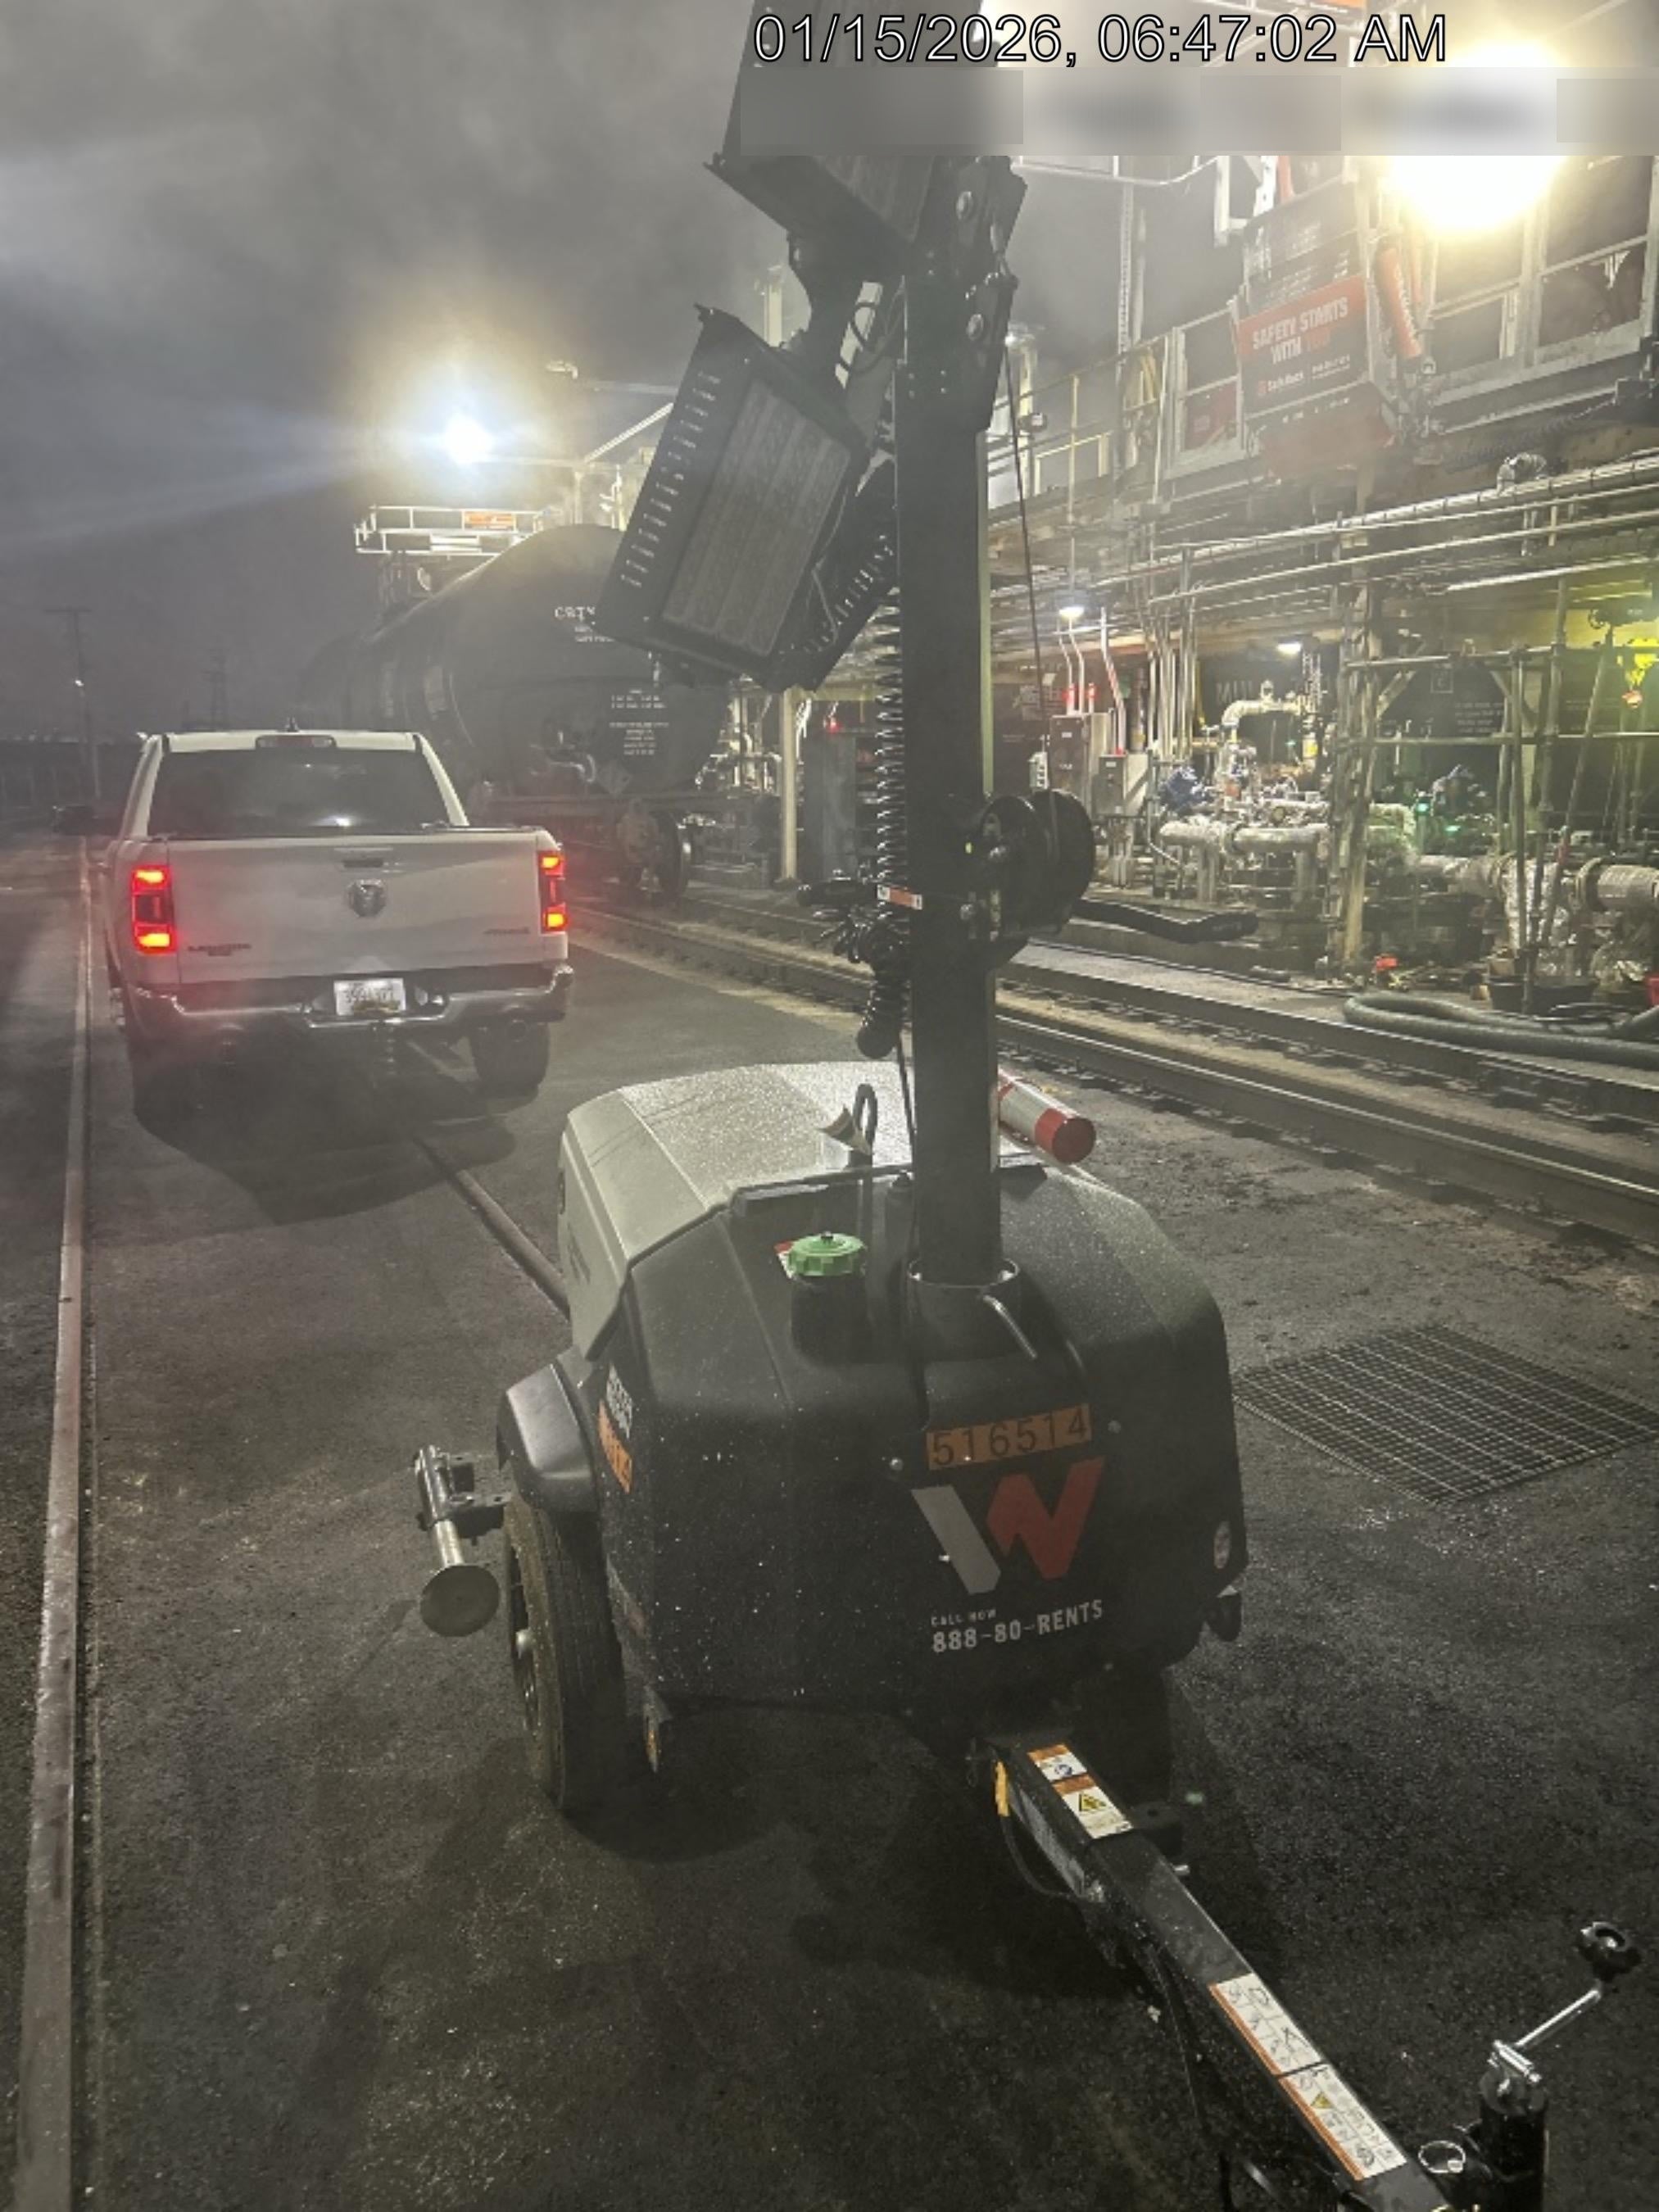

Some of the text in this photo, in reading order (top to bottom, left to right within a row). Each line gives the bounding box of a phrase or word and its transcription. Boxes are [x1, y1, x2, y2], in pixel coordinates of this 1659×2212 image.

[1253, 316, 1296, 350] SAFETY
[1299, 297, 1349, 333] STARTS
[1271, 336, 1302, 365] WITH
[932, 1408, 1088, 1466] 516514
[931, 1598, 1104, 1653] 888-80-RENTS
